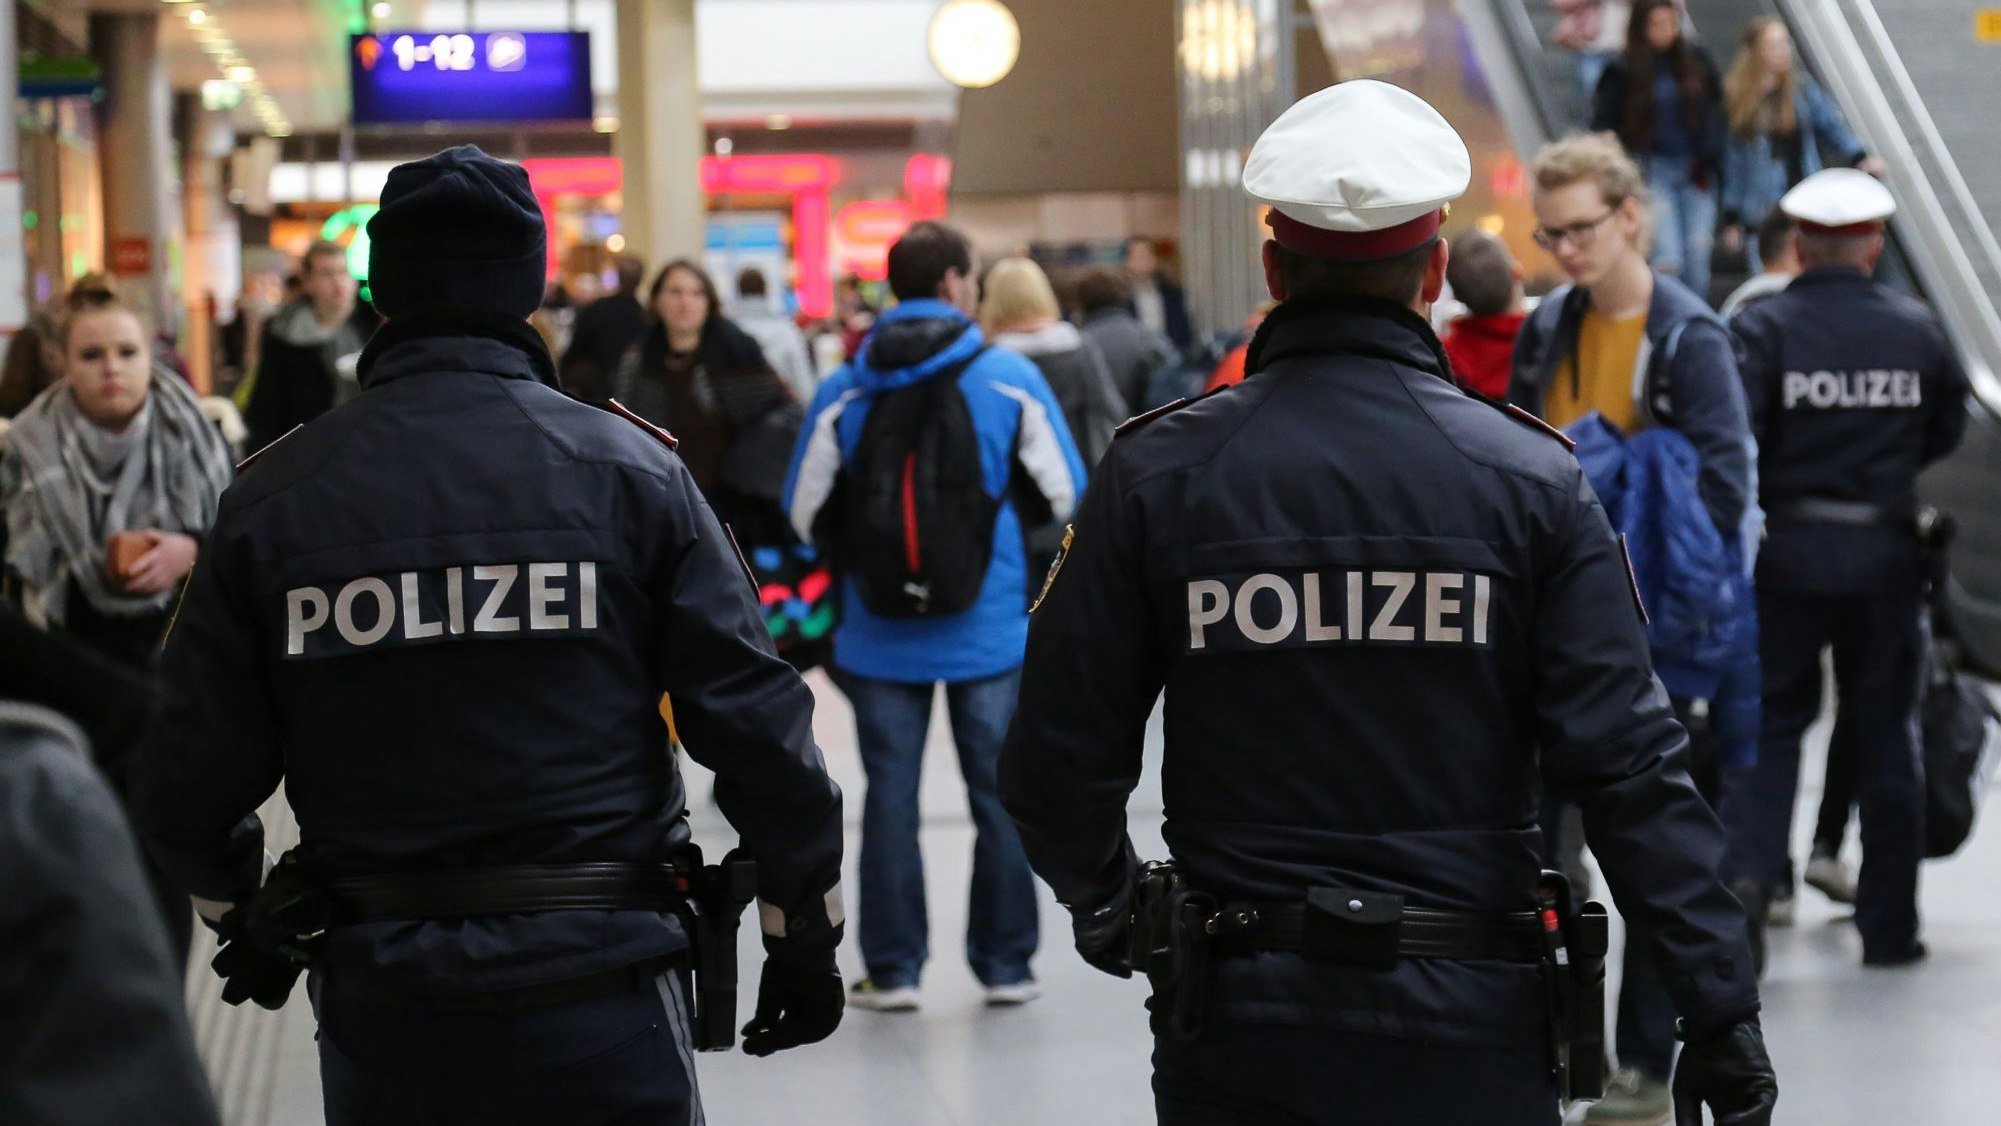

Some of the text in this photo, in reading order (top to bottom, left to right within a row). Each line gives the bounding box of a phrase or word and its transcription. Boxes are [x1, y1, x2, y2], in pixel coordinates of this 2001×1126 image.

[393, 34, 475, 71] 1-12
[1783, 370, 1921, 409] POLIZEI
[286, 562, 598, 655] POLIZEI
[1188, 571, 1490, 648] POLIZEI
